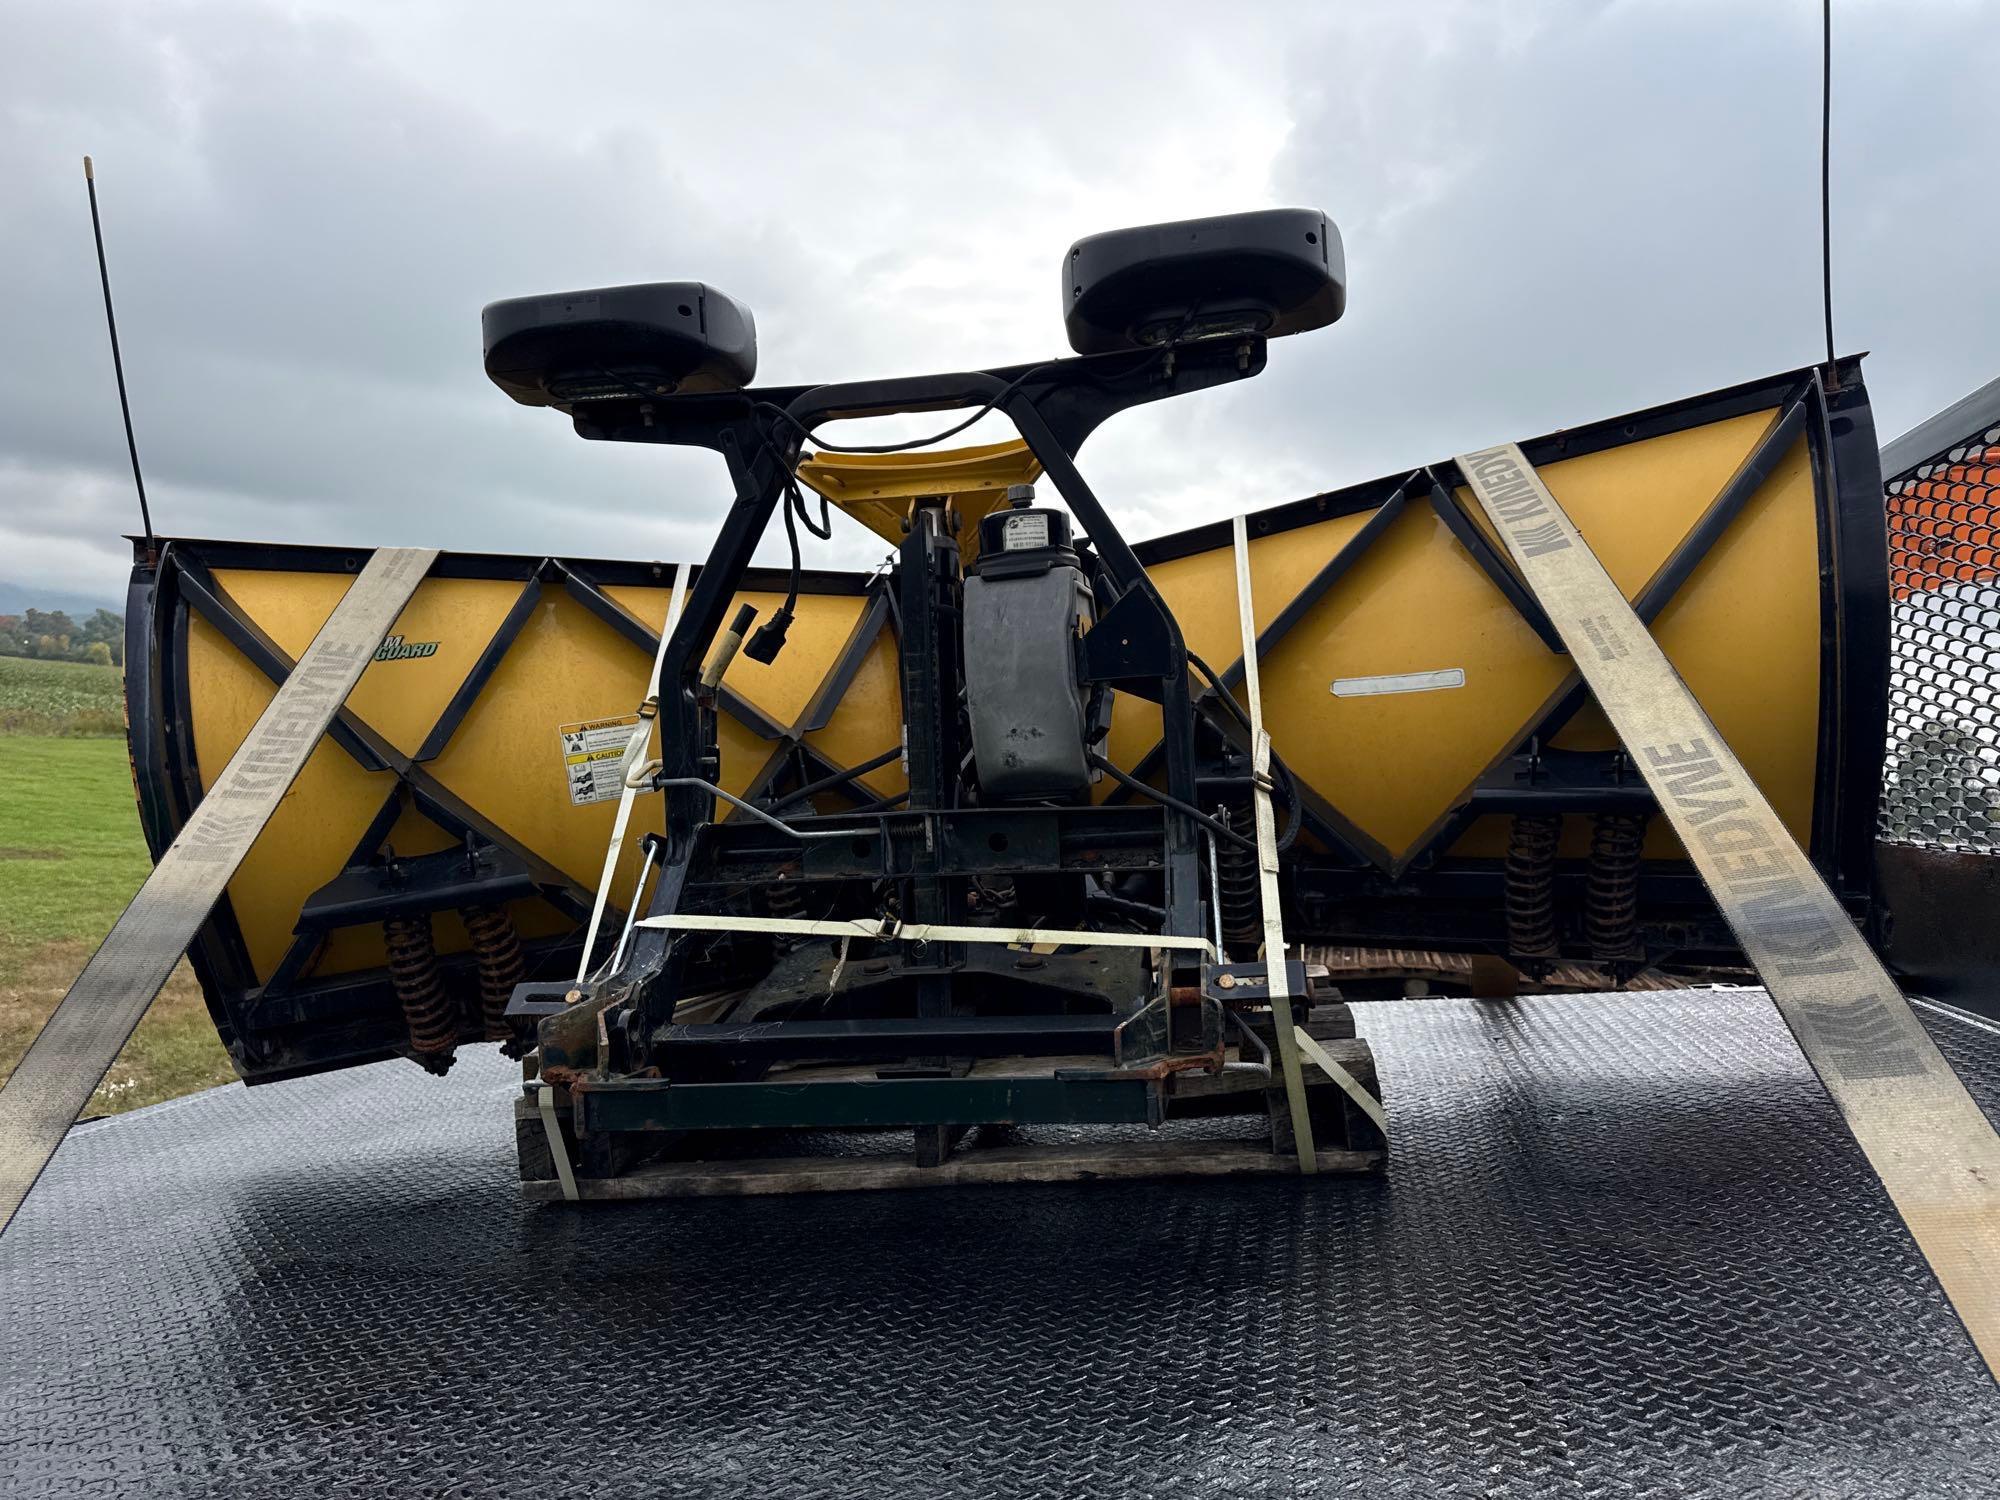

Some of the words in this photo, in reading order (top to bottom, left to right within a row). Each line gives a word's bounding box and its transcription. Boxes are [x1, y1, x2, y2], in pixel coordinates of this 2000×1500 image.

[1464, 449, 1549, 525] KINEDY
[374, 642, 438, 661] GUARD
[219, 640, 365, 800] KINEDYNE
[588, 719, 623, 730] WARNING
[595, 749, 625, 760] CAUTION
[1643, 737, 1861, 978] KINEDYNE
